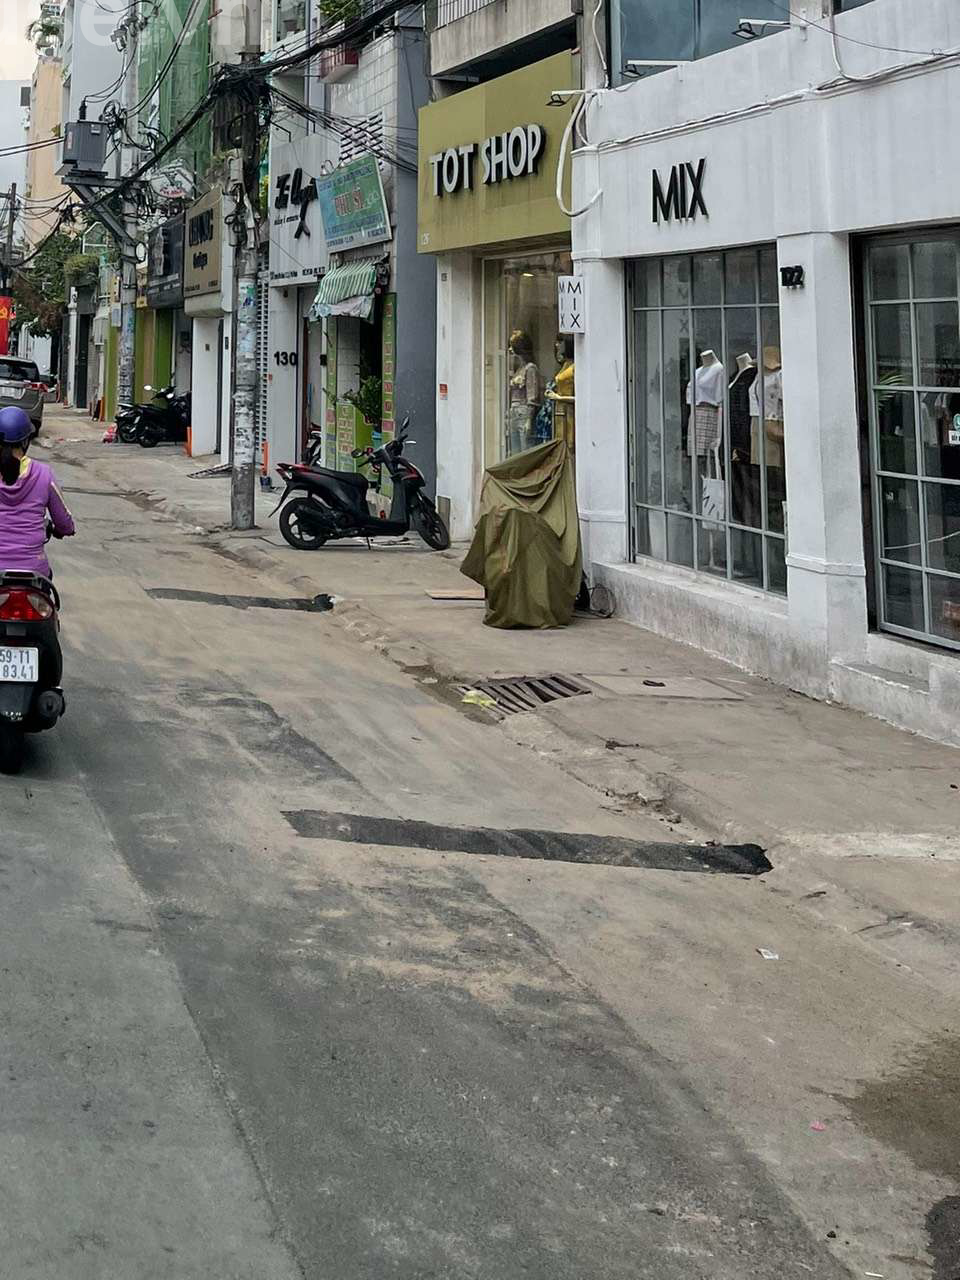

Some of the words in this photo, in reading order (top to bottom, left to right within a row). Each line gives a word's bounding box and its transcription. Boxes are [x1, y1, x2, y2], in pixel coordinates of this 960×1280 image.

[429, 143, 478, 197] TOT
[480, 123, 546, 185] SHOP
[652, 157, 708, 223] MIX
[567, 280, 582, 329] MIX
[274, 351, 298, 366] 130
